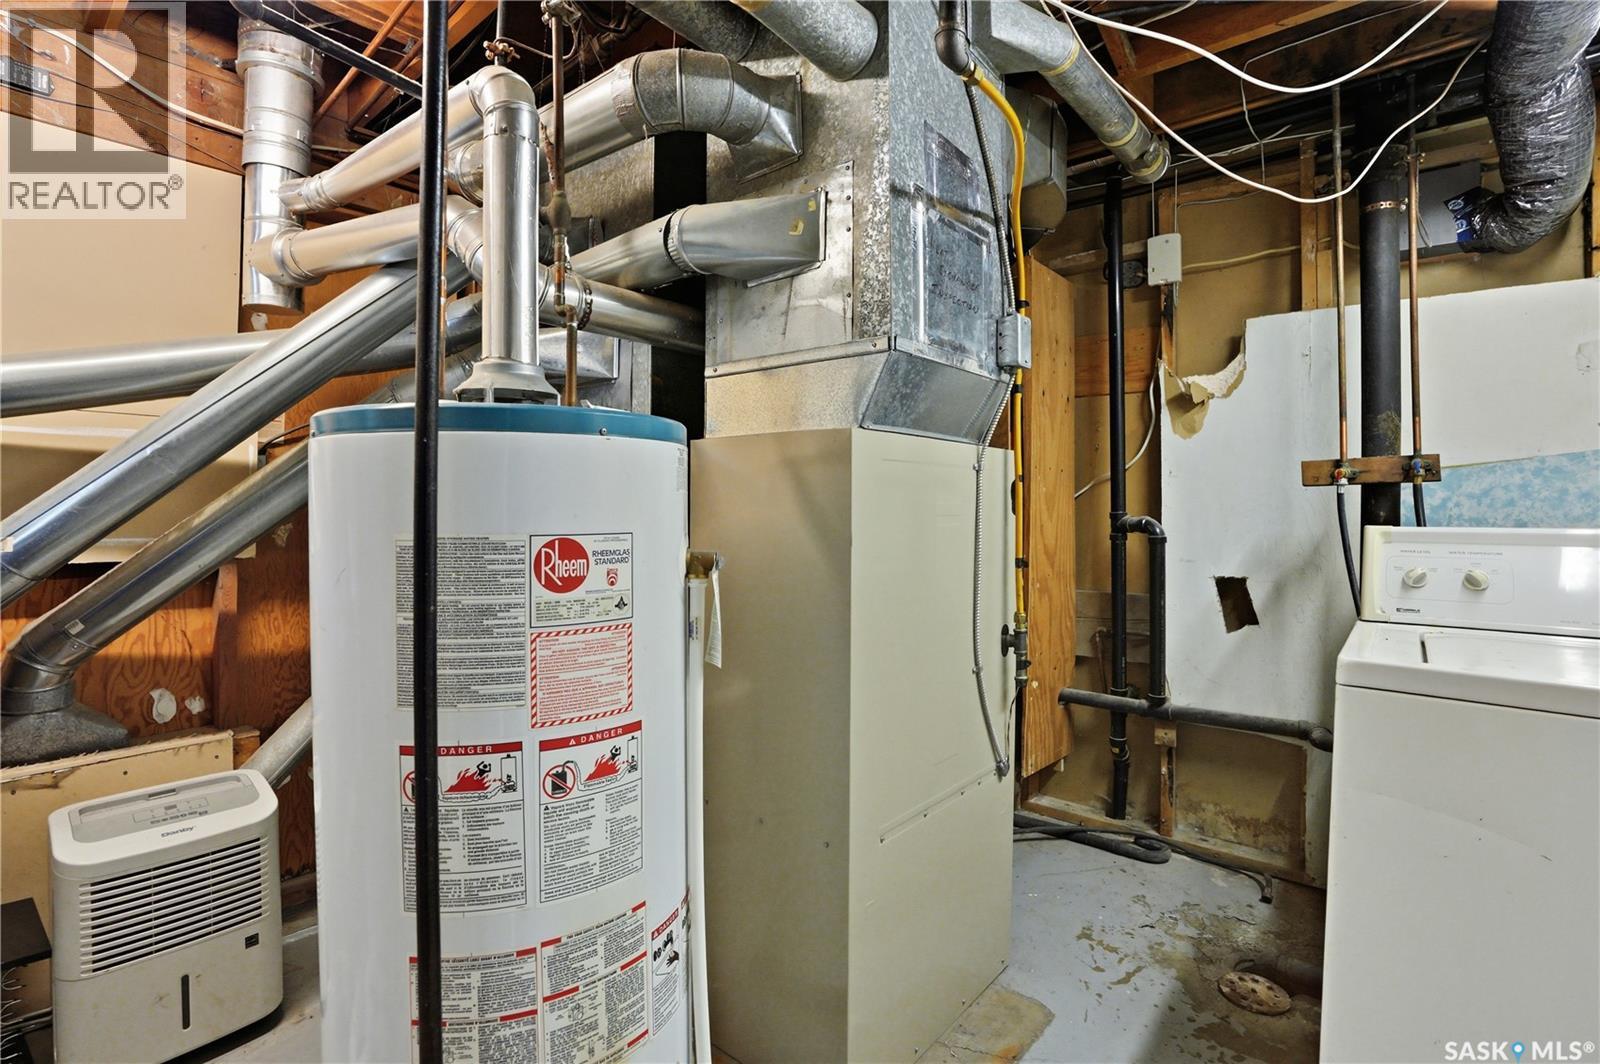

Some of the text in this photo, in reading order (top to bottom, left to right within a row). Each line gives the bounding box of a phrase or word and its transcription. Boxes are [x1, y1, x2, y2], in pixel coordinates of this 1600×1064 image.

[541, 539, 588, 586] Rheem
[594, 556, 630, 566] STANDARD
[580, 728, 623, 743] DANGER
[440, 745, 493, 755] DANGER
[161, 826, 193, 838] Danby
